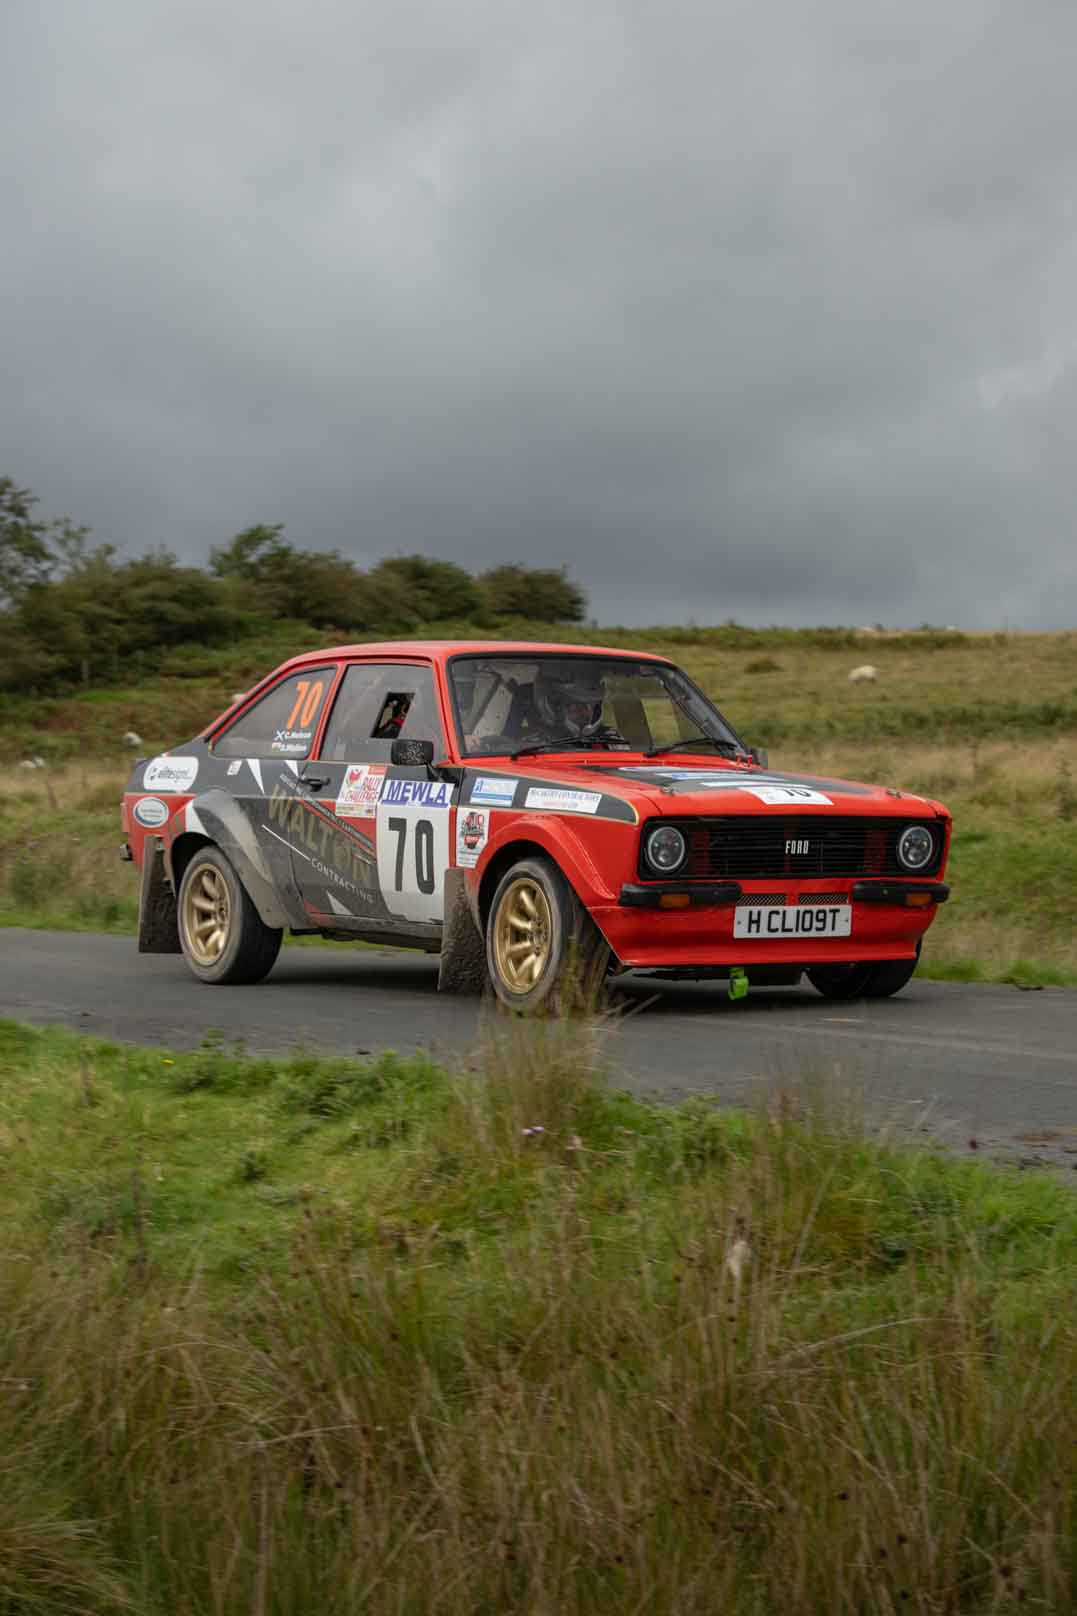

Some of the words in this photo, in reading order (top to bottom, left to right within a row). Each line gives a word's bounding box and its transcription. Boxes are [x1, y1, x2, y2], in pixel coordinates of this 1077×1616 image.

[287, 681, 323, 729] 70
[387, 780, 448, 805] MEWLA
[388, 816, 435, 895] 70
[785, 840, 809, 855] FORD
